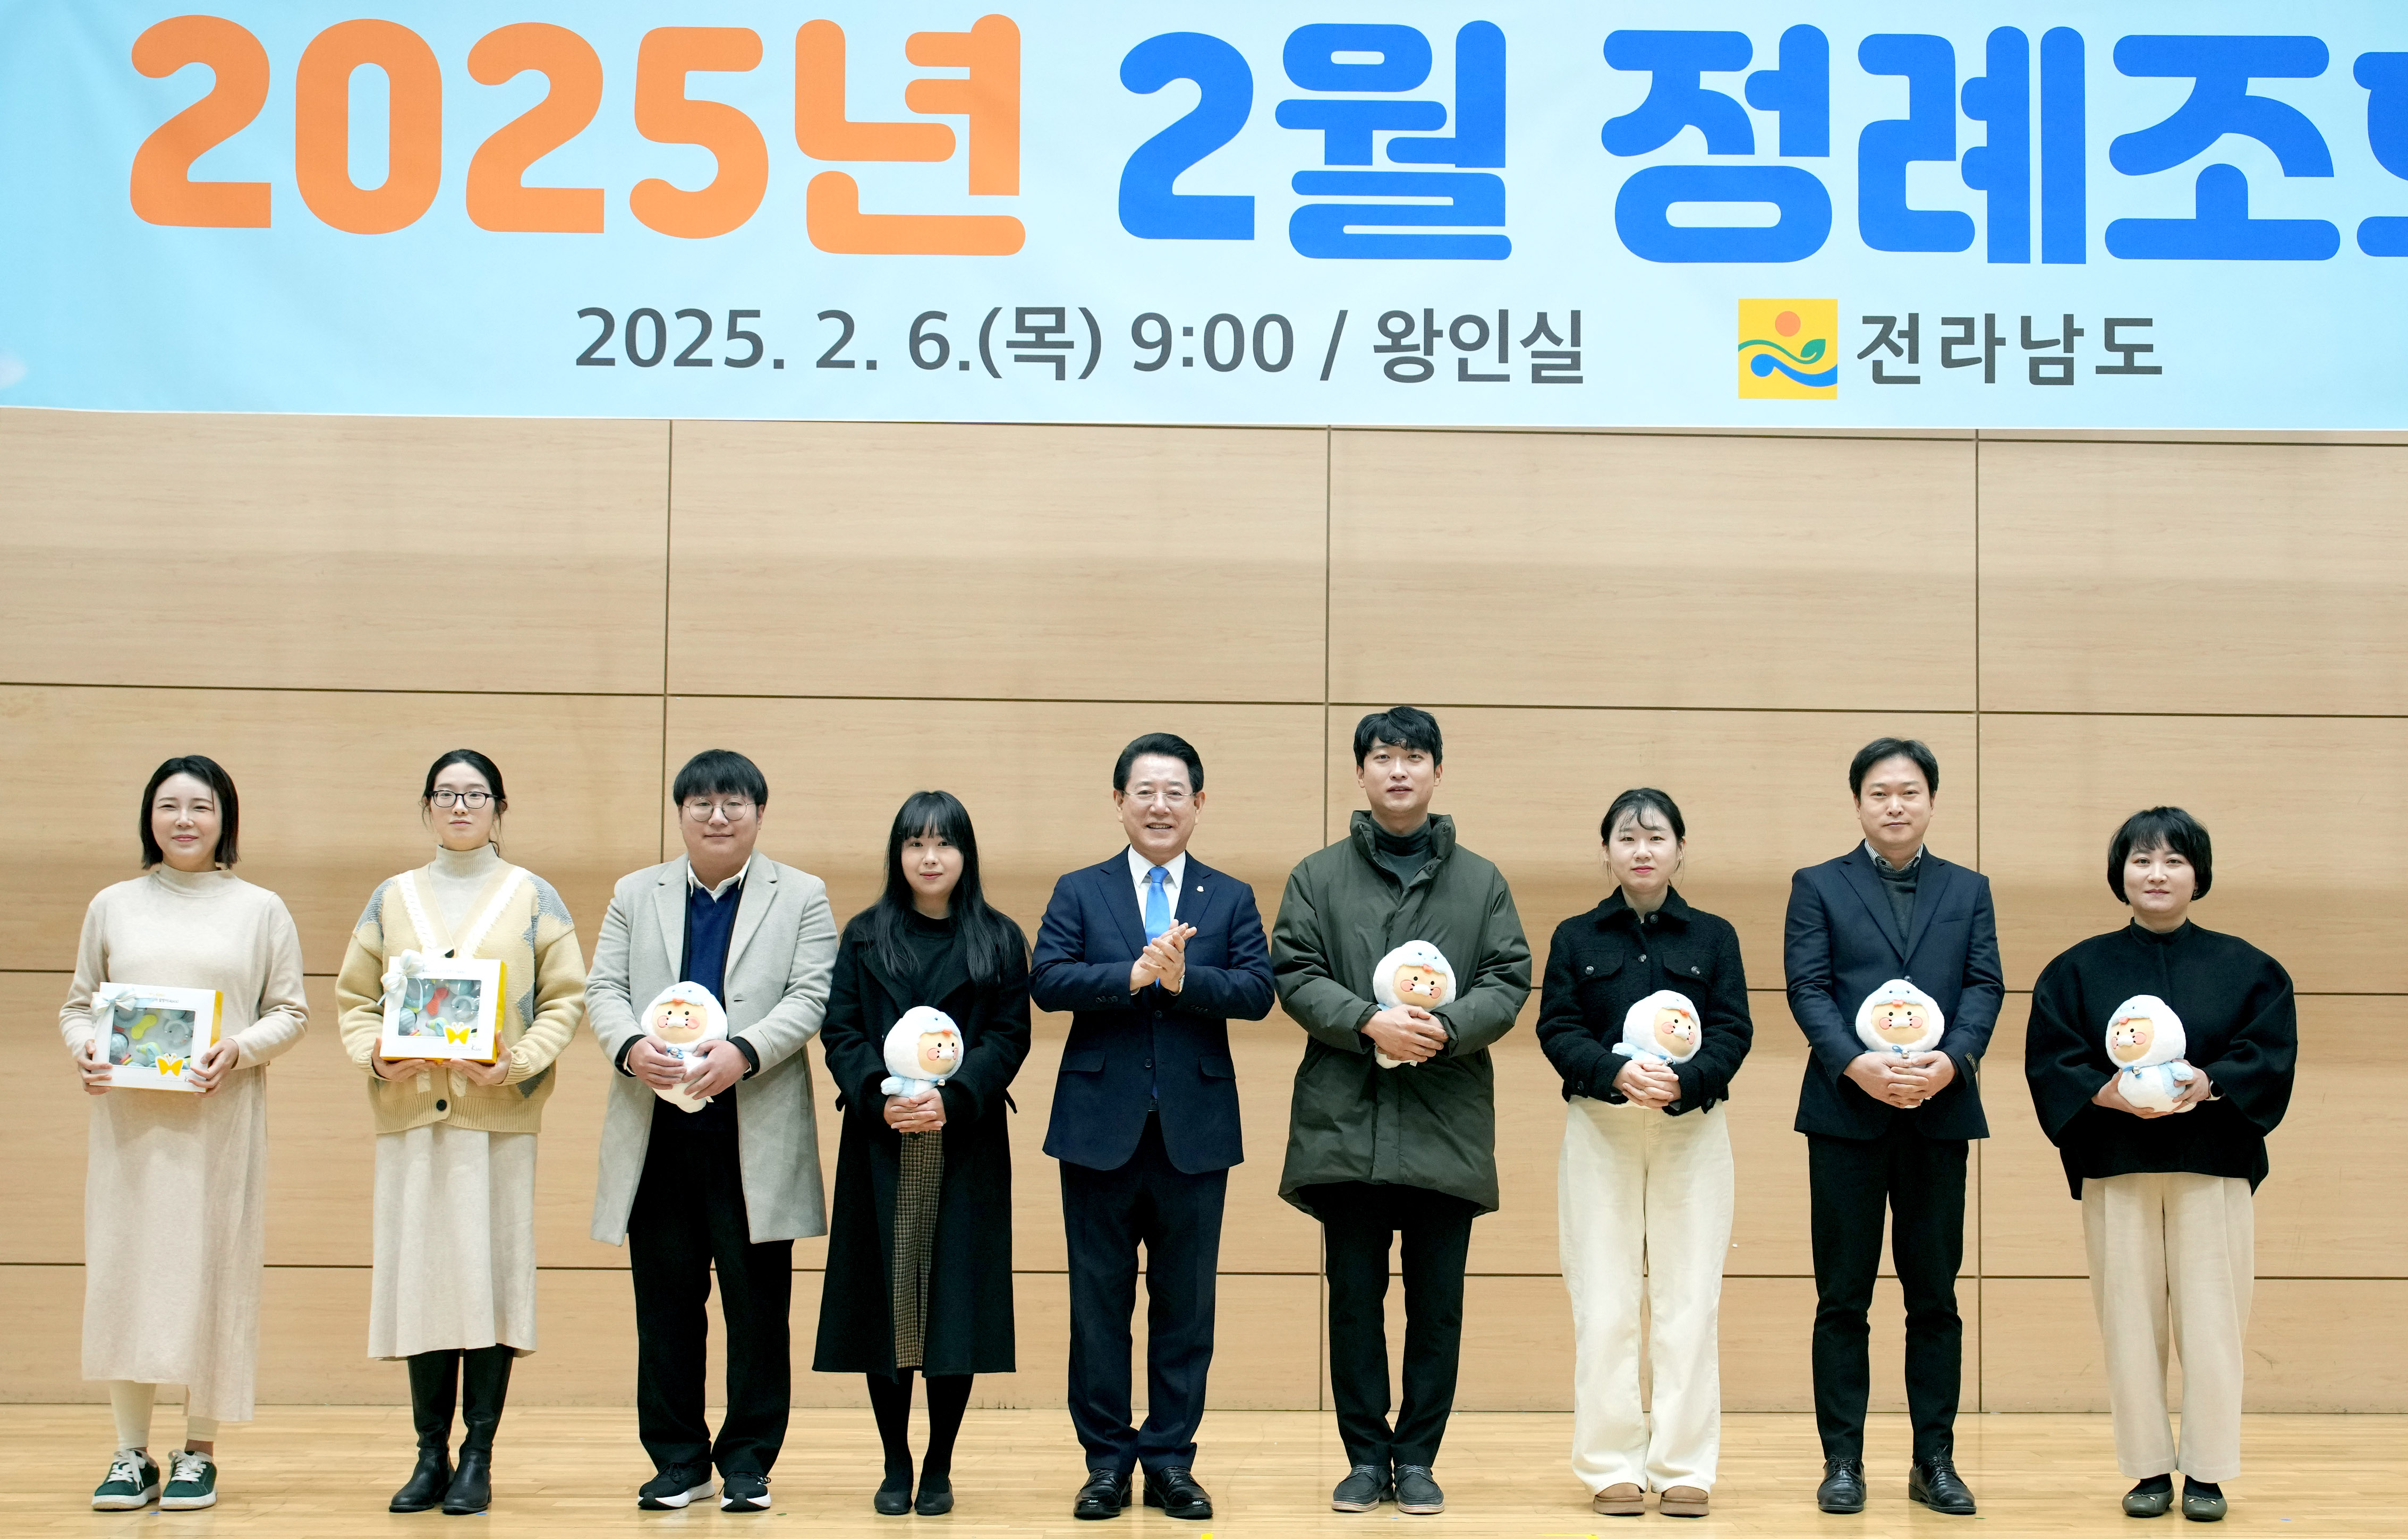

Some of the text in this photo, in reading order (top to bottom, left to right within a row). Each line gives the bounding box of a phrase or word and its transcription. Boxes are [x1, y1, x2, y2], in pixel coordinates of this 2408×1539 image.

[131, 14, 2408, 265] 2025년 2월 정례조
[576, 307, 1583, 384] 2025. 2. 6.(목) 9:00 / 왕인실
[1857, 312, 2162, 386] 전라남도
